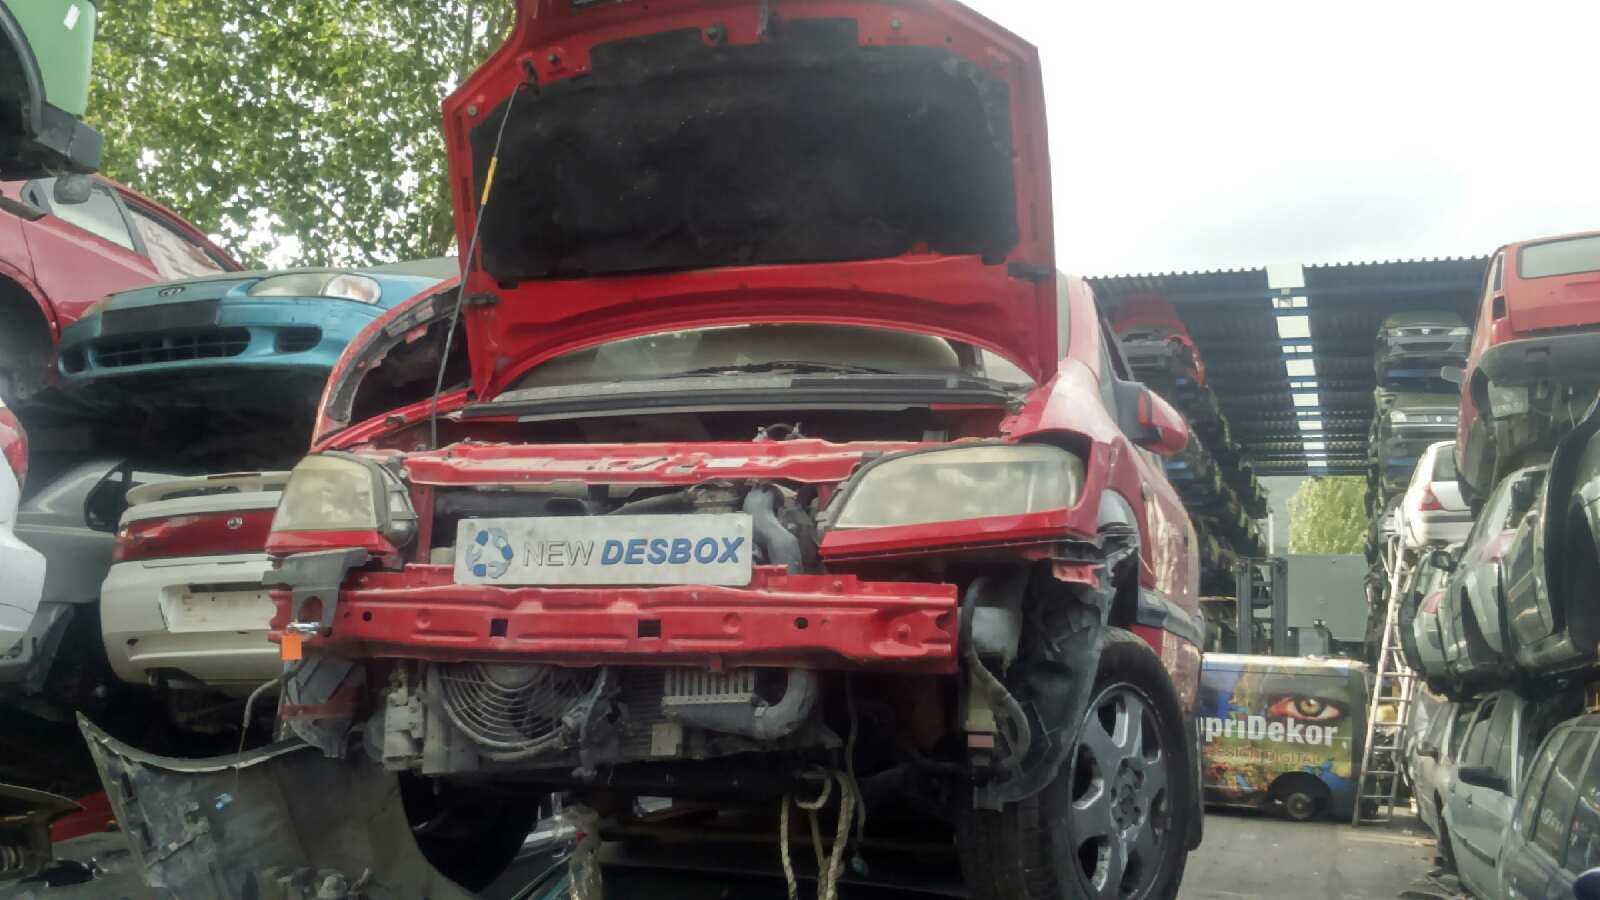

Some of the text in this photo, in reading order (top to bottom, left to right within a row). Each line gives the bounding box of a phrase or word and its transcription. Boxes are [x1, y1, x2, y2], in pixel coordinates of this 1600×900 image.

[523, 536, 745, 567] NEW DESBOX
[1200, 715, 1338, 746] priDekor
